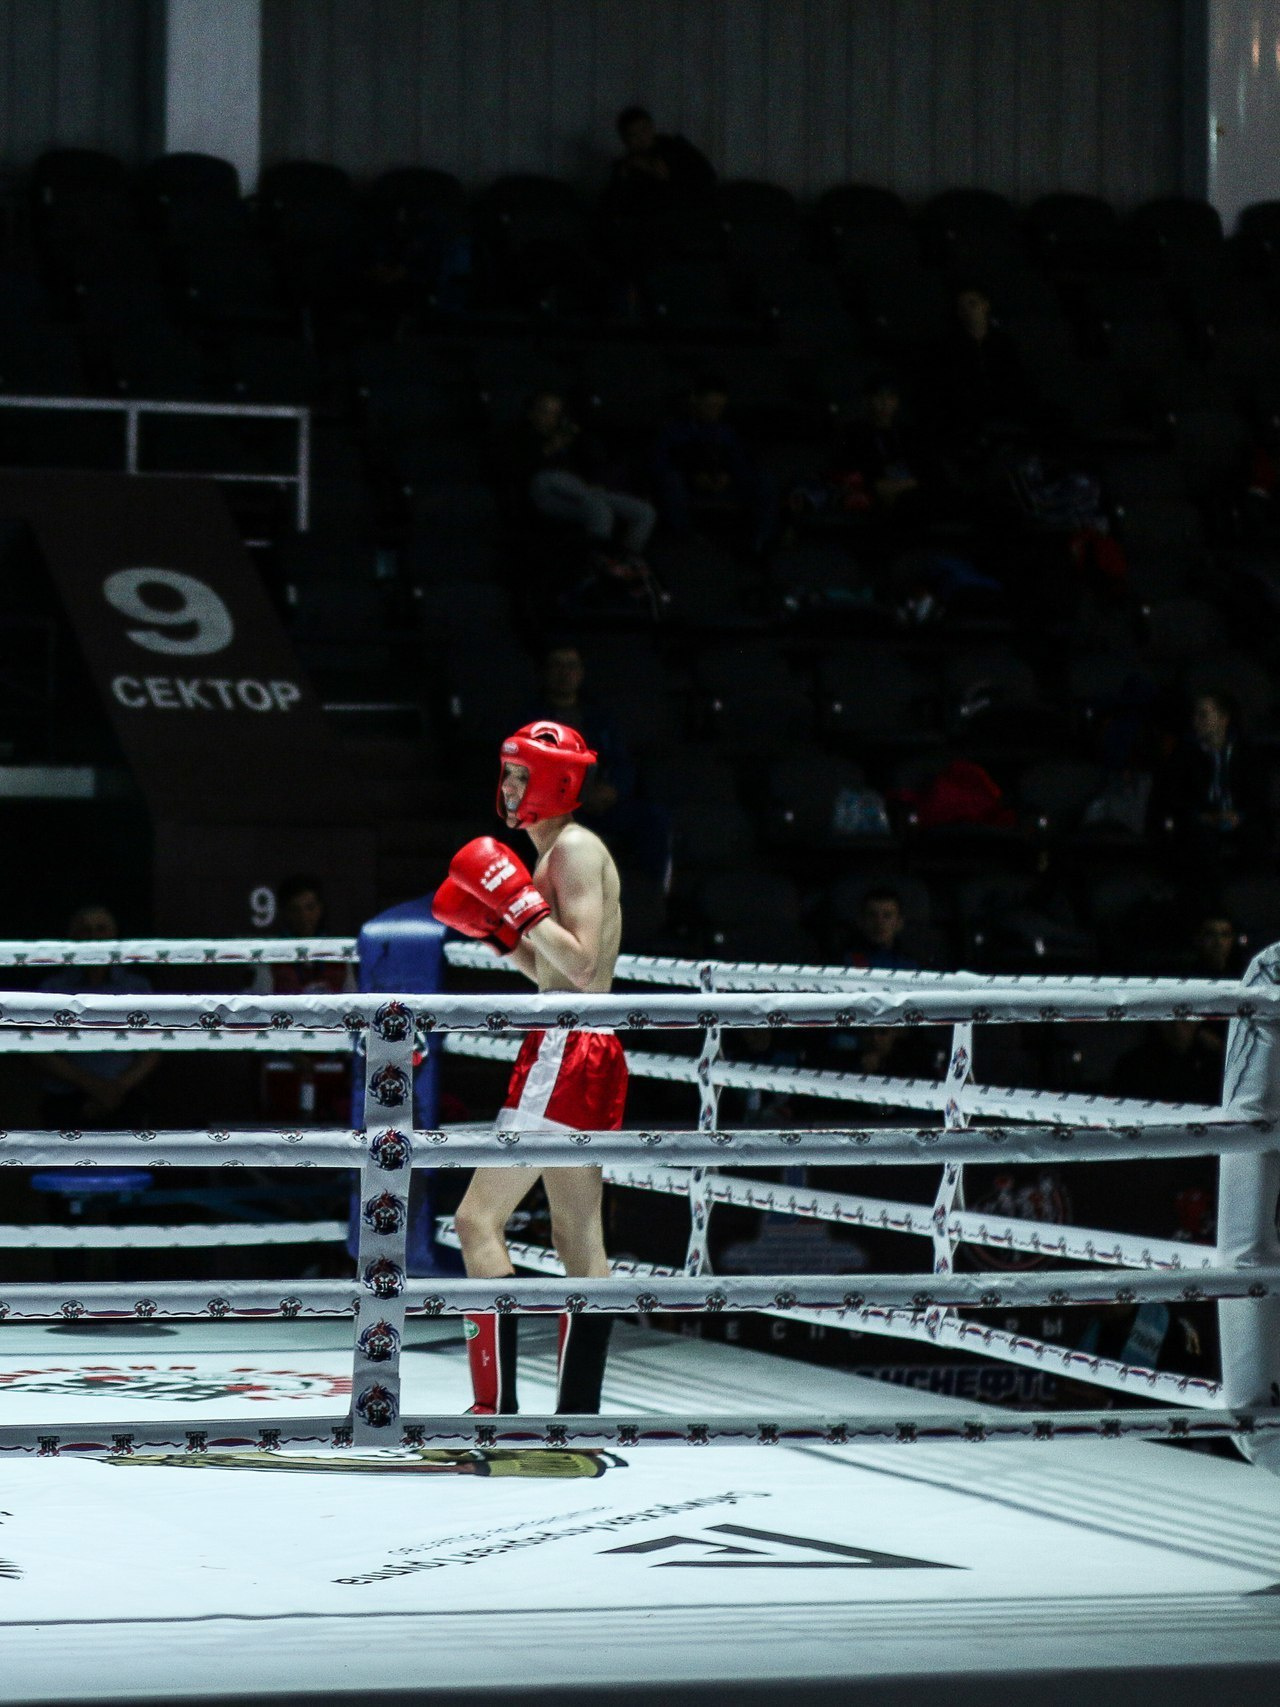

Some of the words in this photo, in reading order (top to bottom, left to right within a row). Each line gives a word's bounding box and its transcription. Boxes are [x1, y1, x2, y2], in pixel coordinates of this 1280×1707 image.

[103, 567, 234, 656] 9
[111, 674, 302, 713] СЕКТОР
[250, 887, 277, 928] 9
